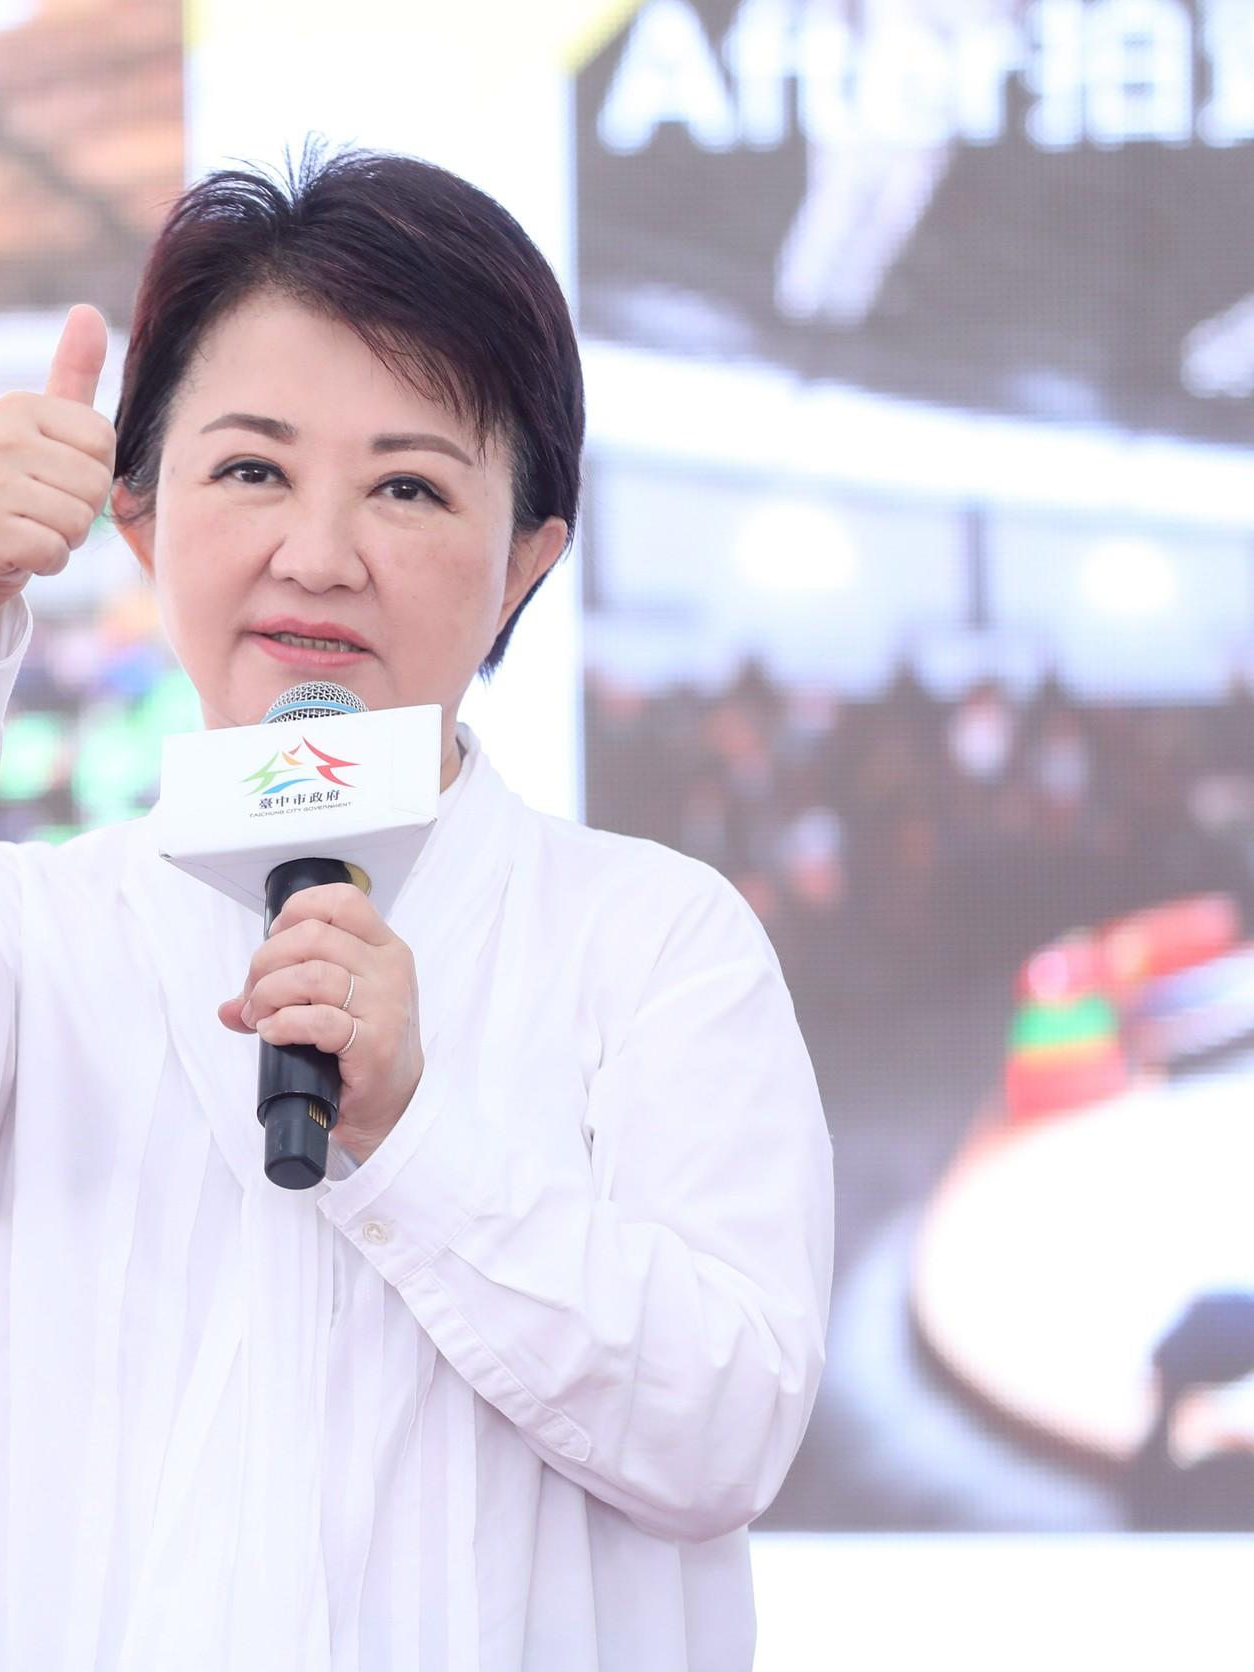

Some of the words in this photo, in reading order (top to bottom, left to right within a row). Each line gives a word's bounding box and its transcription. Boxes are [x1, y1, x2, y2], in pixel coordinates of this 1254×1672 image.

[259, 789, 340, 809] 臺中市政府
[249, 809, 285, 818] TAICHUNG
[286, 807, 302, 815] CITY
[303, 801, 354, 813] GOVERNMENT
